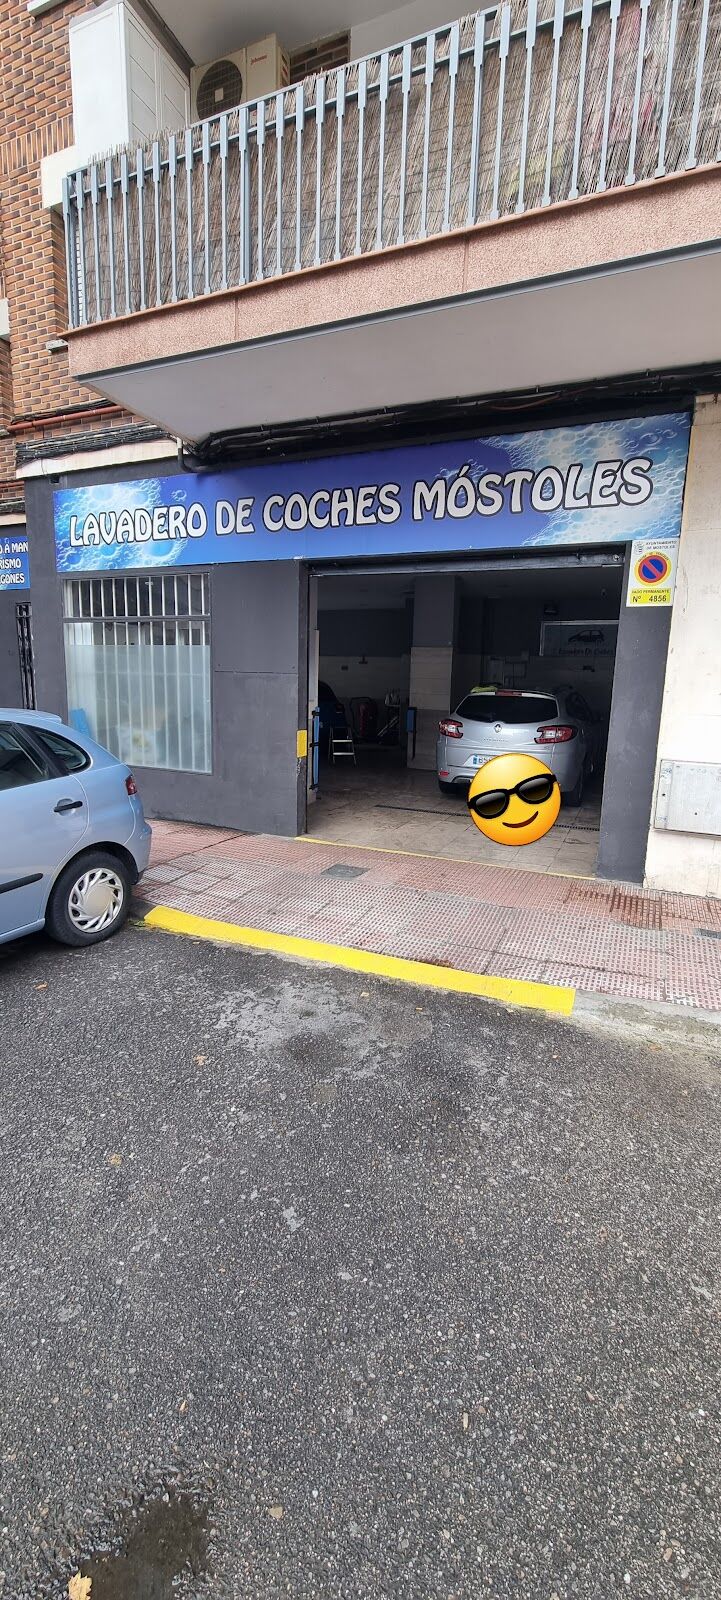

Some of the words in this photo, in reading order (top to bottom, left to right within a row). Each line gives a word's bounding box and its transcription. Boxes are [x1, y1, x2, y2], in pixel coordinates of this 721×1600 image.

[69, 502, 207, 548] LAVADERO
[214, 497, 255, 537] DE
[263, 481, 401, 533] COCHES
[412, 457, 655, 521] MÓSTOLES
